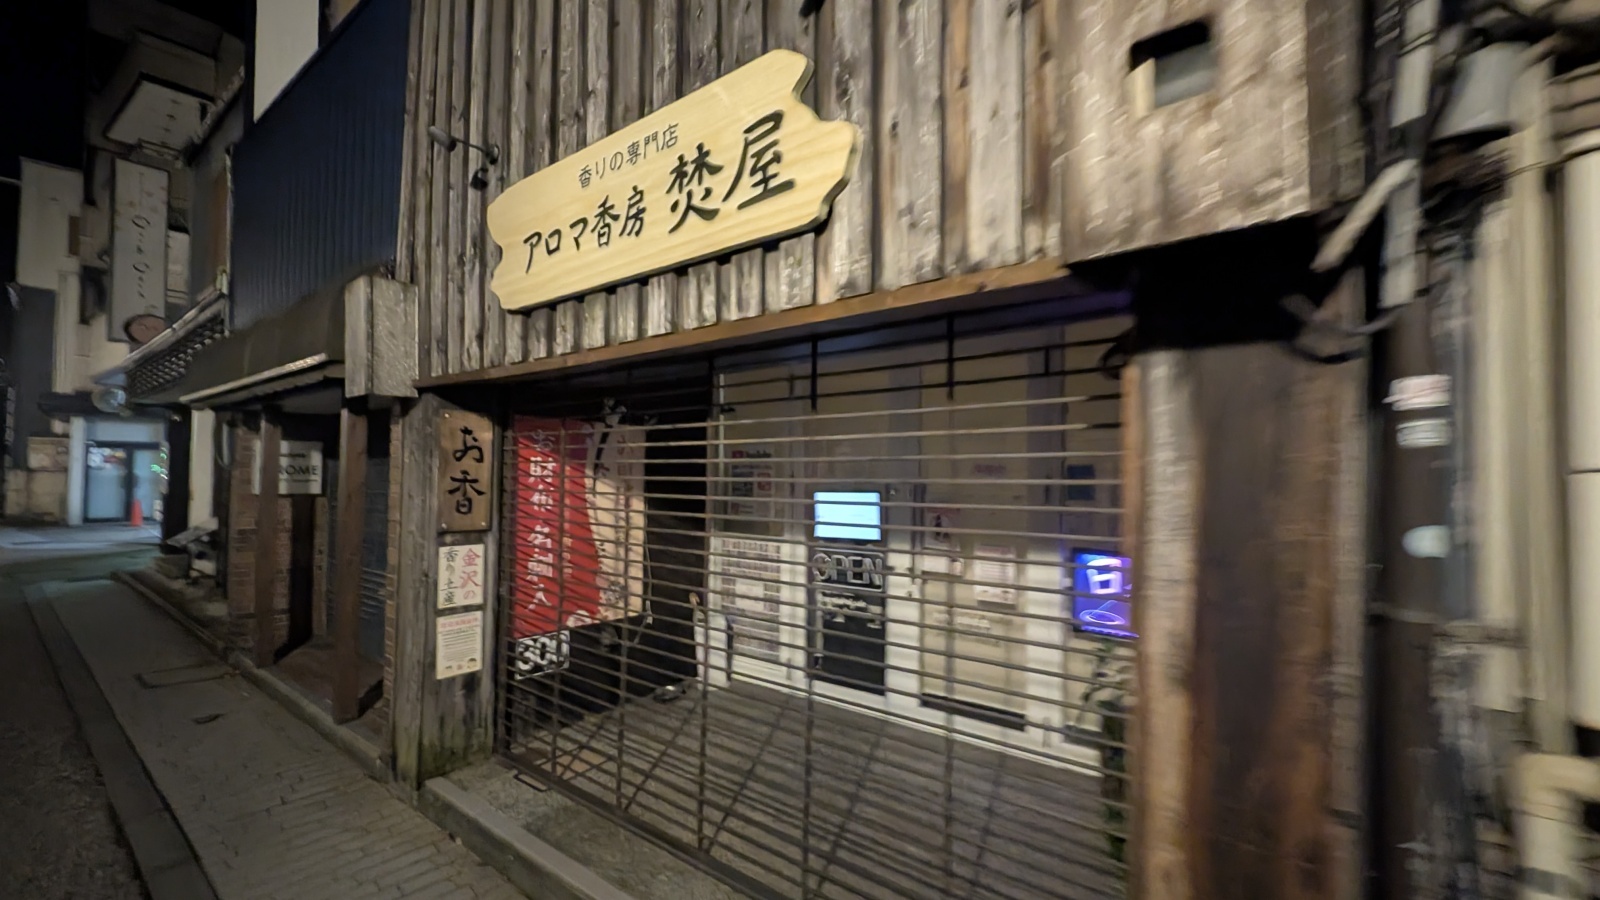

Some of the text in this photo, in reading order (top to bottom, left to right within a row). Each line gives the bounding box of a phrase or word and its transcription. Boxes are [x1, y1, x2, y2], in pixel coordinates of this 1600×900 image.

[578, 122, 680, 189] 香りの専門店
[522, 108, 797, 274] アロマ香房 焚屋
[447, 425, 487, 516] お香
[459, 547, 482, 601] 金沢の
[812, 552, 883, 587] OPEN
